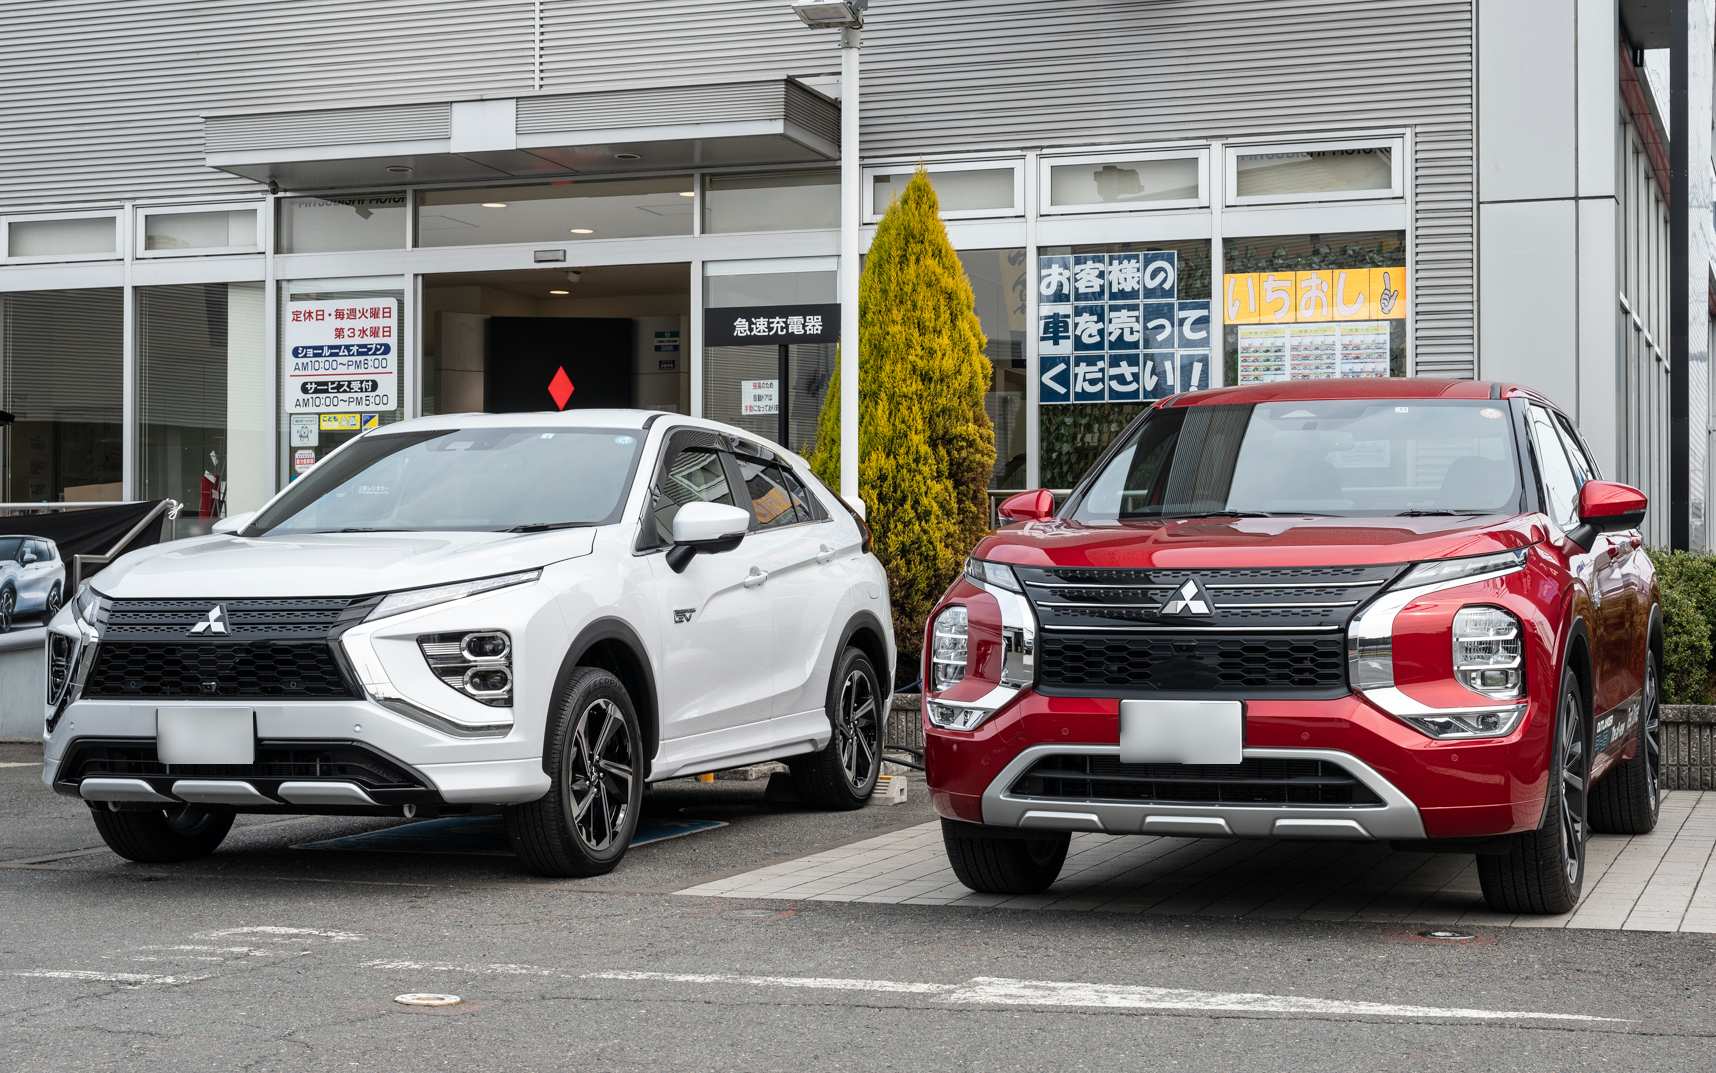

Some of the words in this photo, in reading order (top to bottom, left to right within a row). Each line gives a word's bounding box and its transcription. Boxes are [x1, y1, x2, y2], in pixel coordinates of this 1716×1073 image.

[1039, 259, 1175, 296] お客様の
[1227, 271, 1366, 321] いちおし
[291, 307, 392, 322] 定休日・毎週火曜日
[334, 326, 392, 340] 第3水曜日
[733, 315, 823, 337] 急速充電器
[1039, 309, 1209, 346] 車を売って
[298, 343, 385, 357] ショールームオープン
[306, 380, 373, 393] サービス受付
[1041, 360, 1203, 395] ください！
